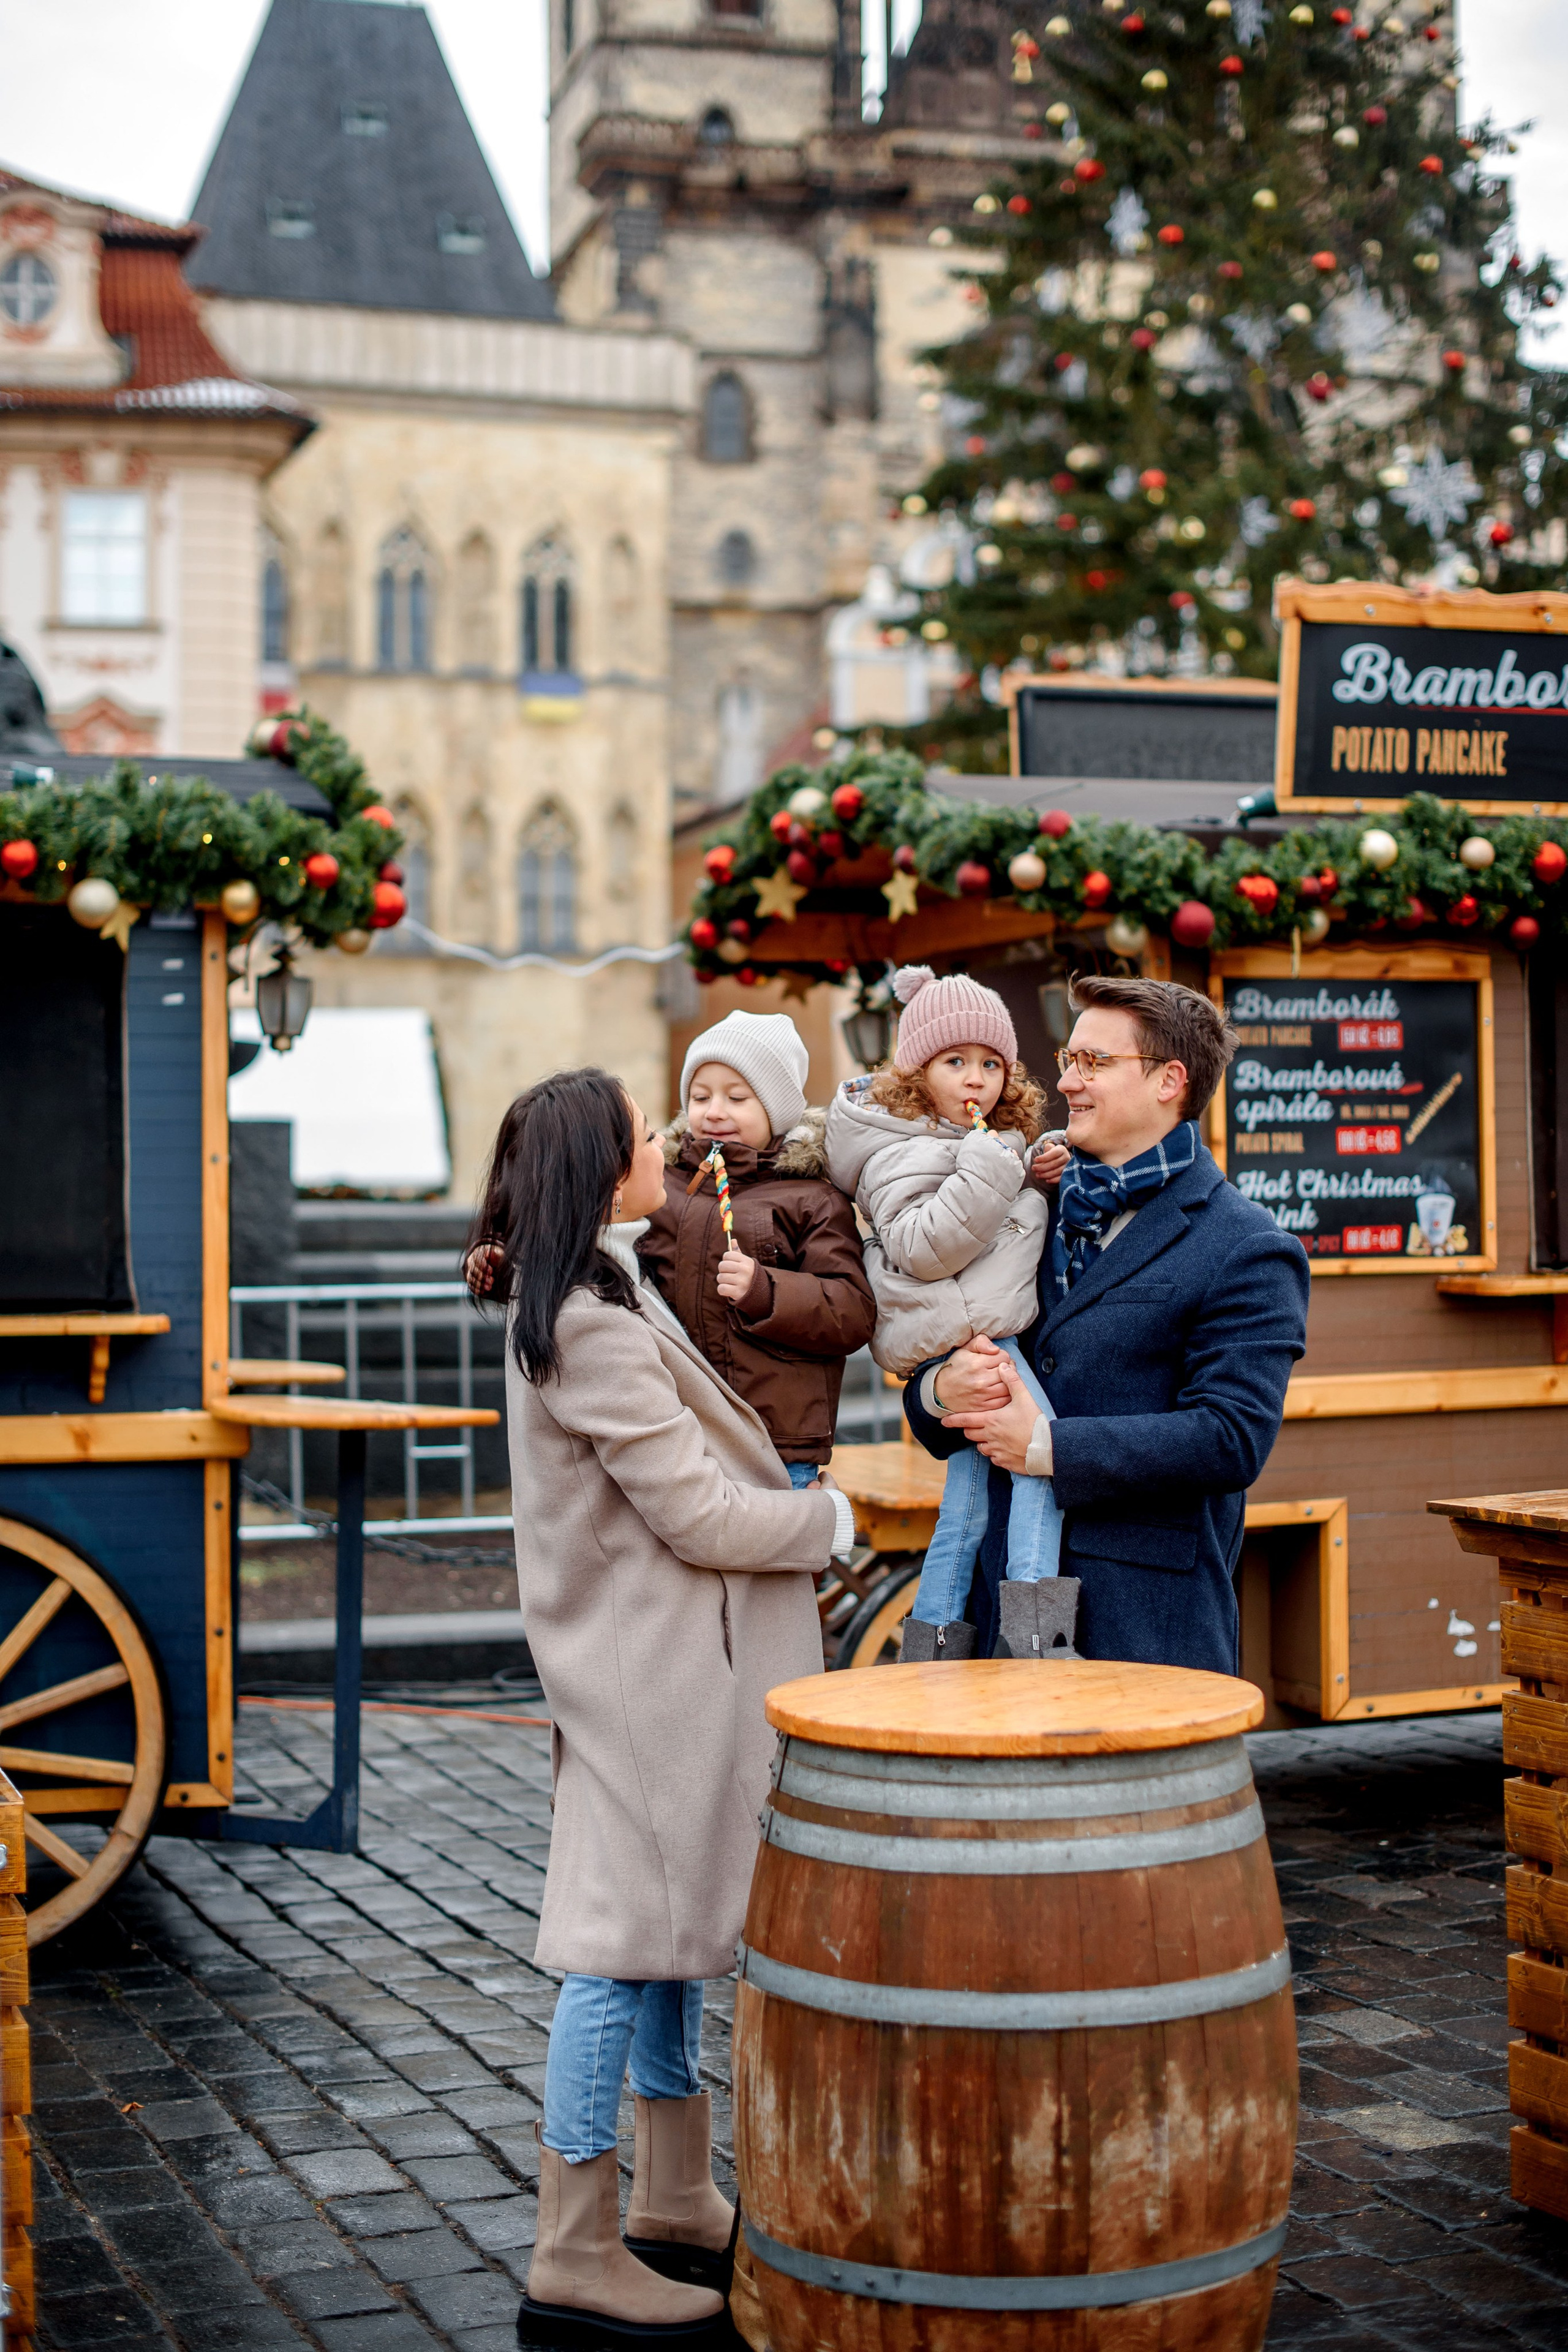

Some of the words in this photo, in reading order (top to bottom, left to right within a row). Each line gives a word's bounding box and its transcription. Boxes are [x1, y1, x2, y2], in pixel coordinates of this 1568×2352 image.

[1331, 725, 1409, 774] POTATO
[1415, 728, 1509, 776] PANCAKE
[1233, 987, 1400, 1020] Bramborák
[1233, 1060, 1405, 1092] Bramborová
[1234, 1090, 1335, 1133] spirála
[1236, 1169, 1292, 1200] Hot
[1296, 1168, 1426, 1199] Christmas
[1252, 1199, 1319, 1230] ink
